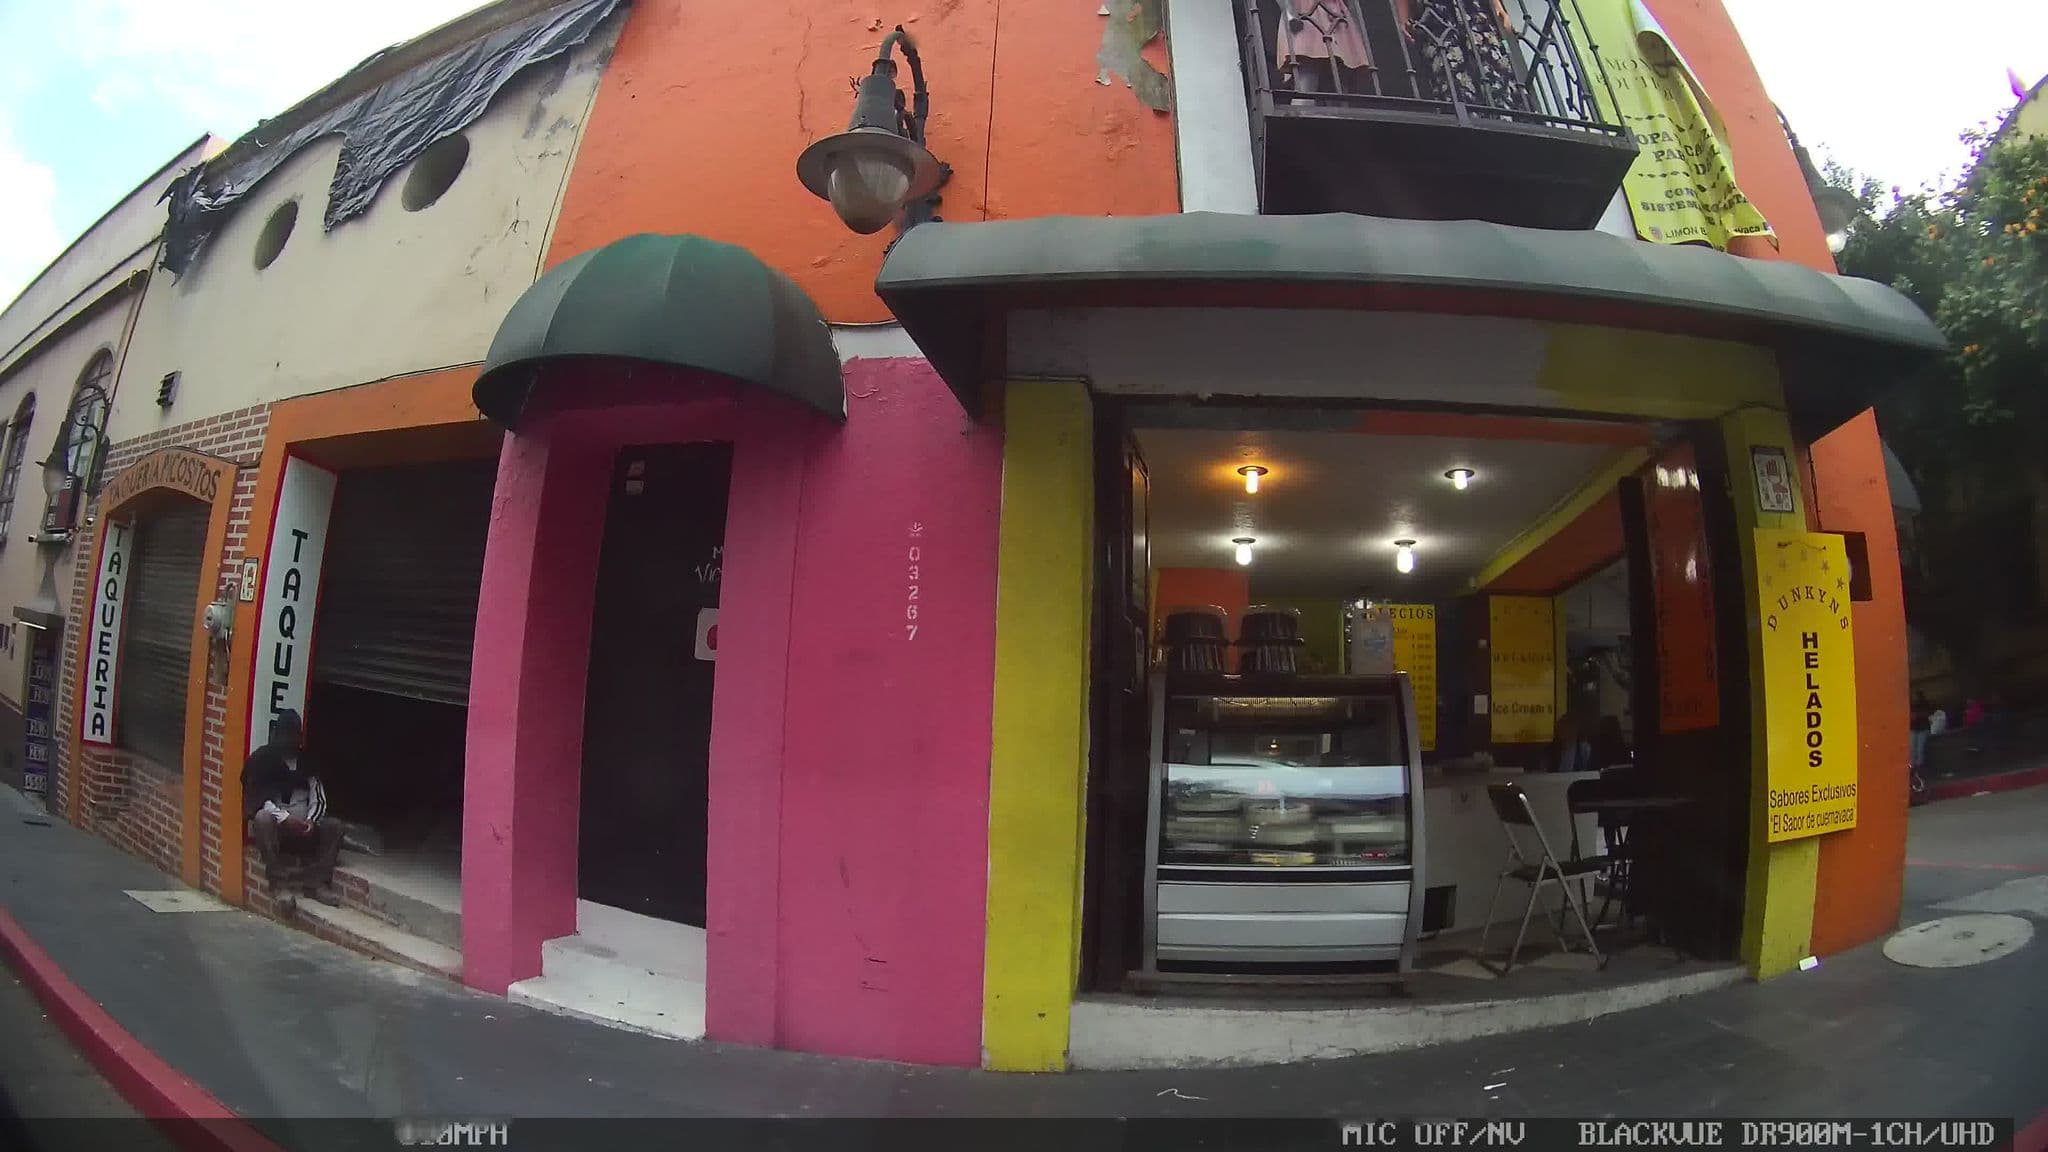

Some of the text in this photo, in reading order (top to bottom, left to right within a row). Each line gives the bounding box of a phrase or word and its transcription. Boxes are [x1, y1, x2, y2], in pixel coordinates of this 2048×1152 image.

[91, 523, 129, 736] TAQUERIA
[1767, 586, 1849, 632] DUNKYNS
[1801, 631, 1823, 768] HELADOS
[1769, 782, 1857, 808] Sabores Exclusivos
[1783, 812, 1805, 832] Sabor
[1806, 811, 1816, 829] de
